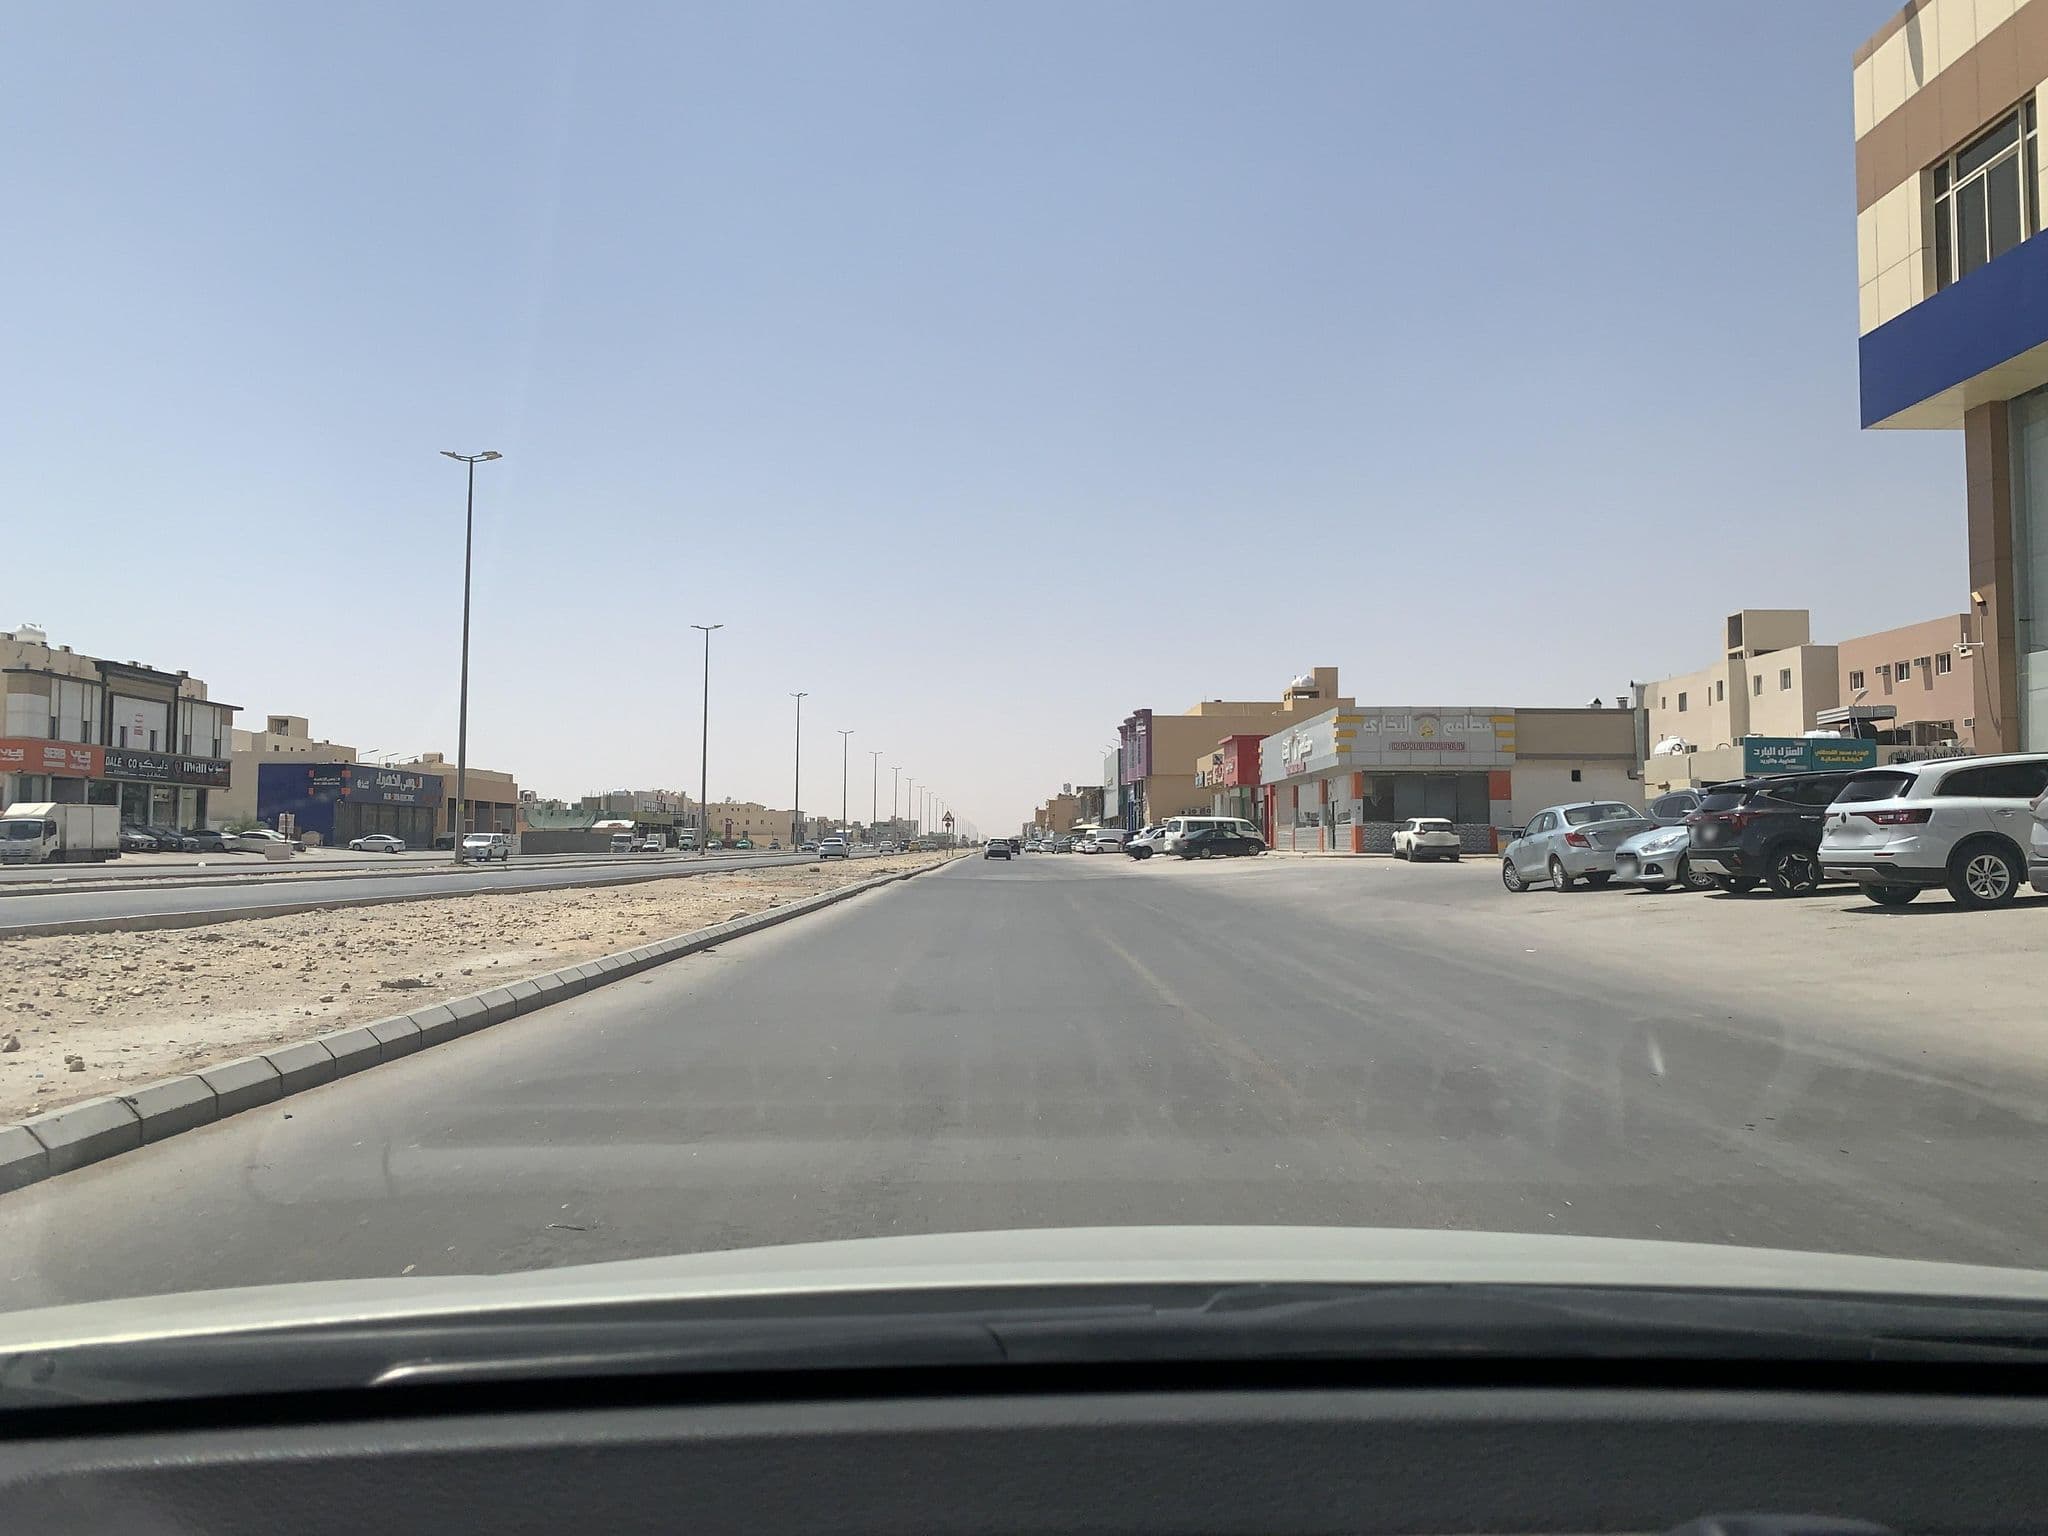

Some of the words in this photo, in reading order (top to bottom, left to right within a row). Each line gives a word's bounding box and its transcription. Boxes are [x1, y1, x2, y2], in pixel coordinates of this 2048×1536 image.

[1363, 715, 1411, 736] البخاري
[1753, 746, 1776, 758] البارد
[1778, 746, 1803, 758] المنزل
[105, 756, 122, 767] DALE
[128, 758, 137, 769] CO
